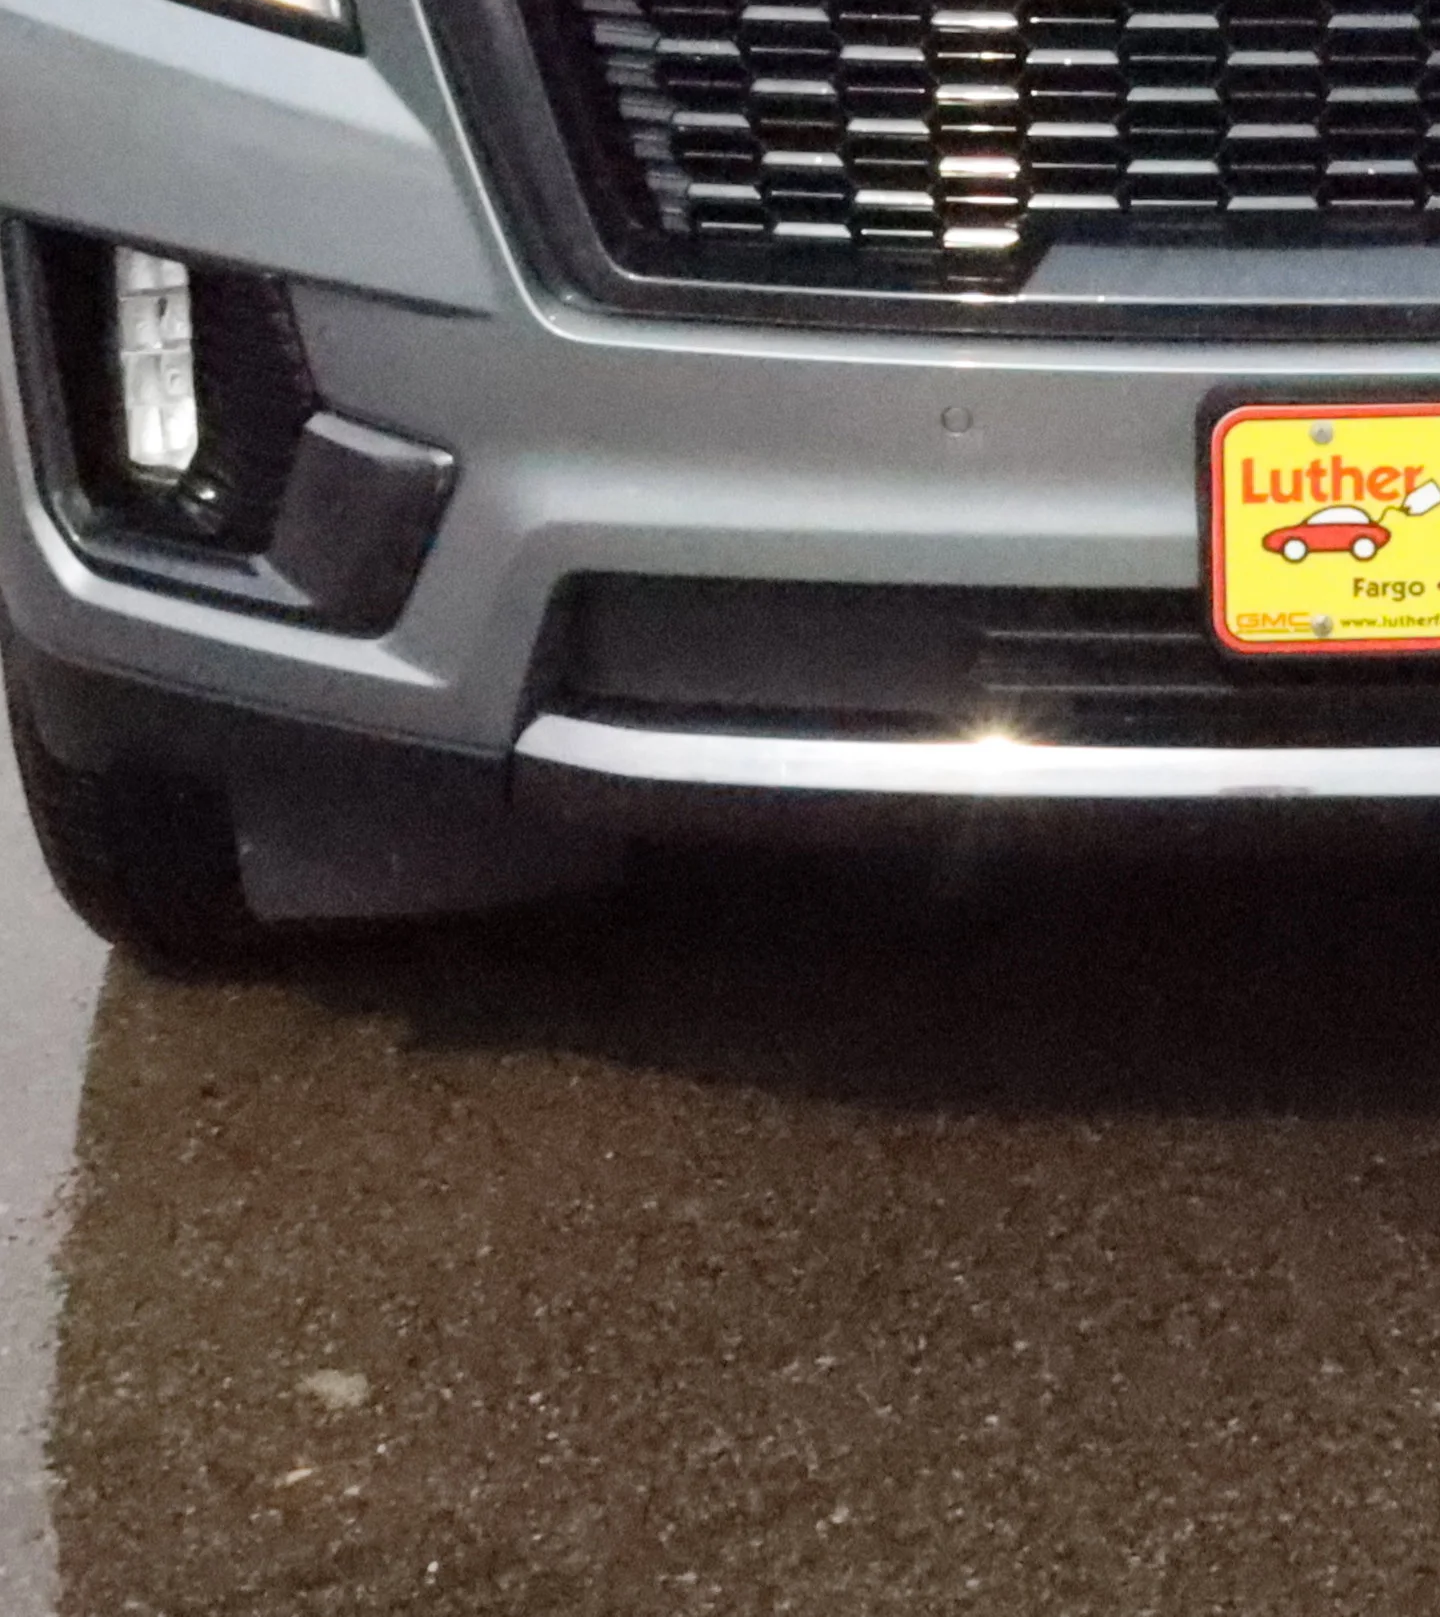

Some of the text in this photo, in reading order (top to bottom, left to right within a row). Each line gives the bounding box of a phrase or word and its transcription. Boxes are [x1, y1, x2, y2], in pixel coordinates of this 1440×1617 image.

[1241, 454, 1425, 504] Luther
[1353, 577, 1426, 602] Fargo
[1236, 611, 1311, 629] GMC
